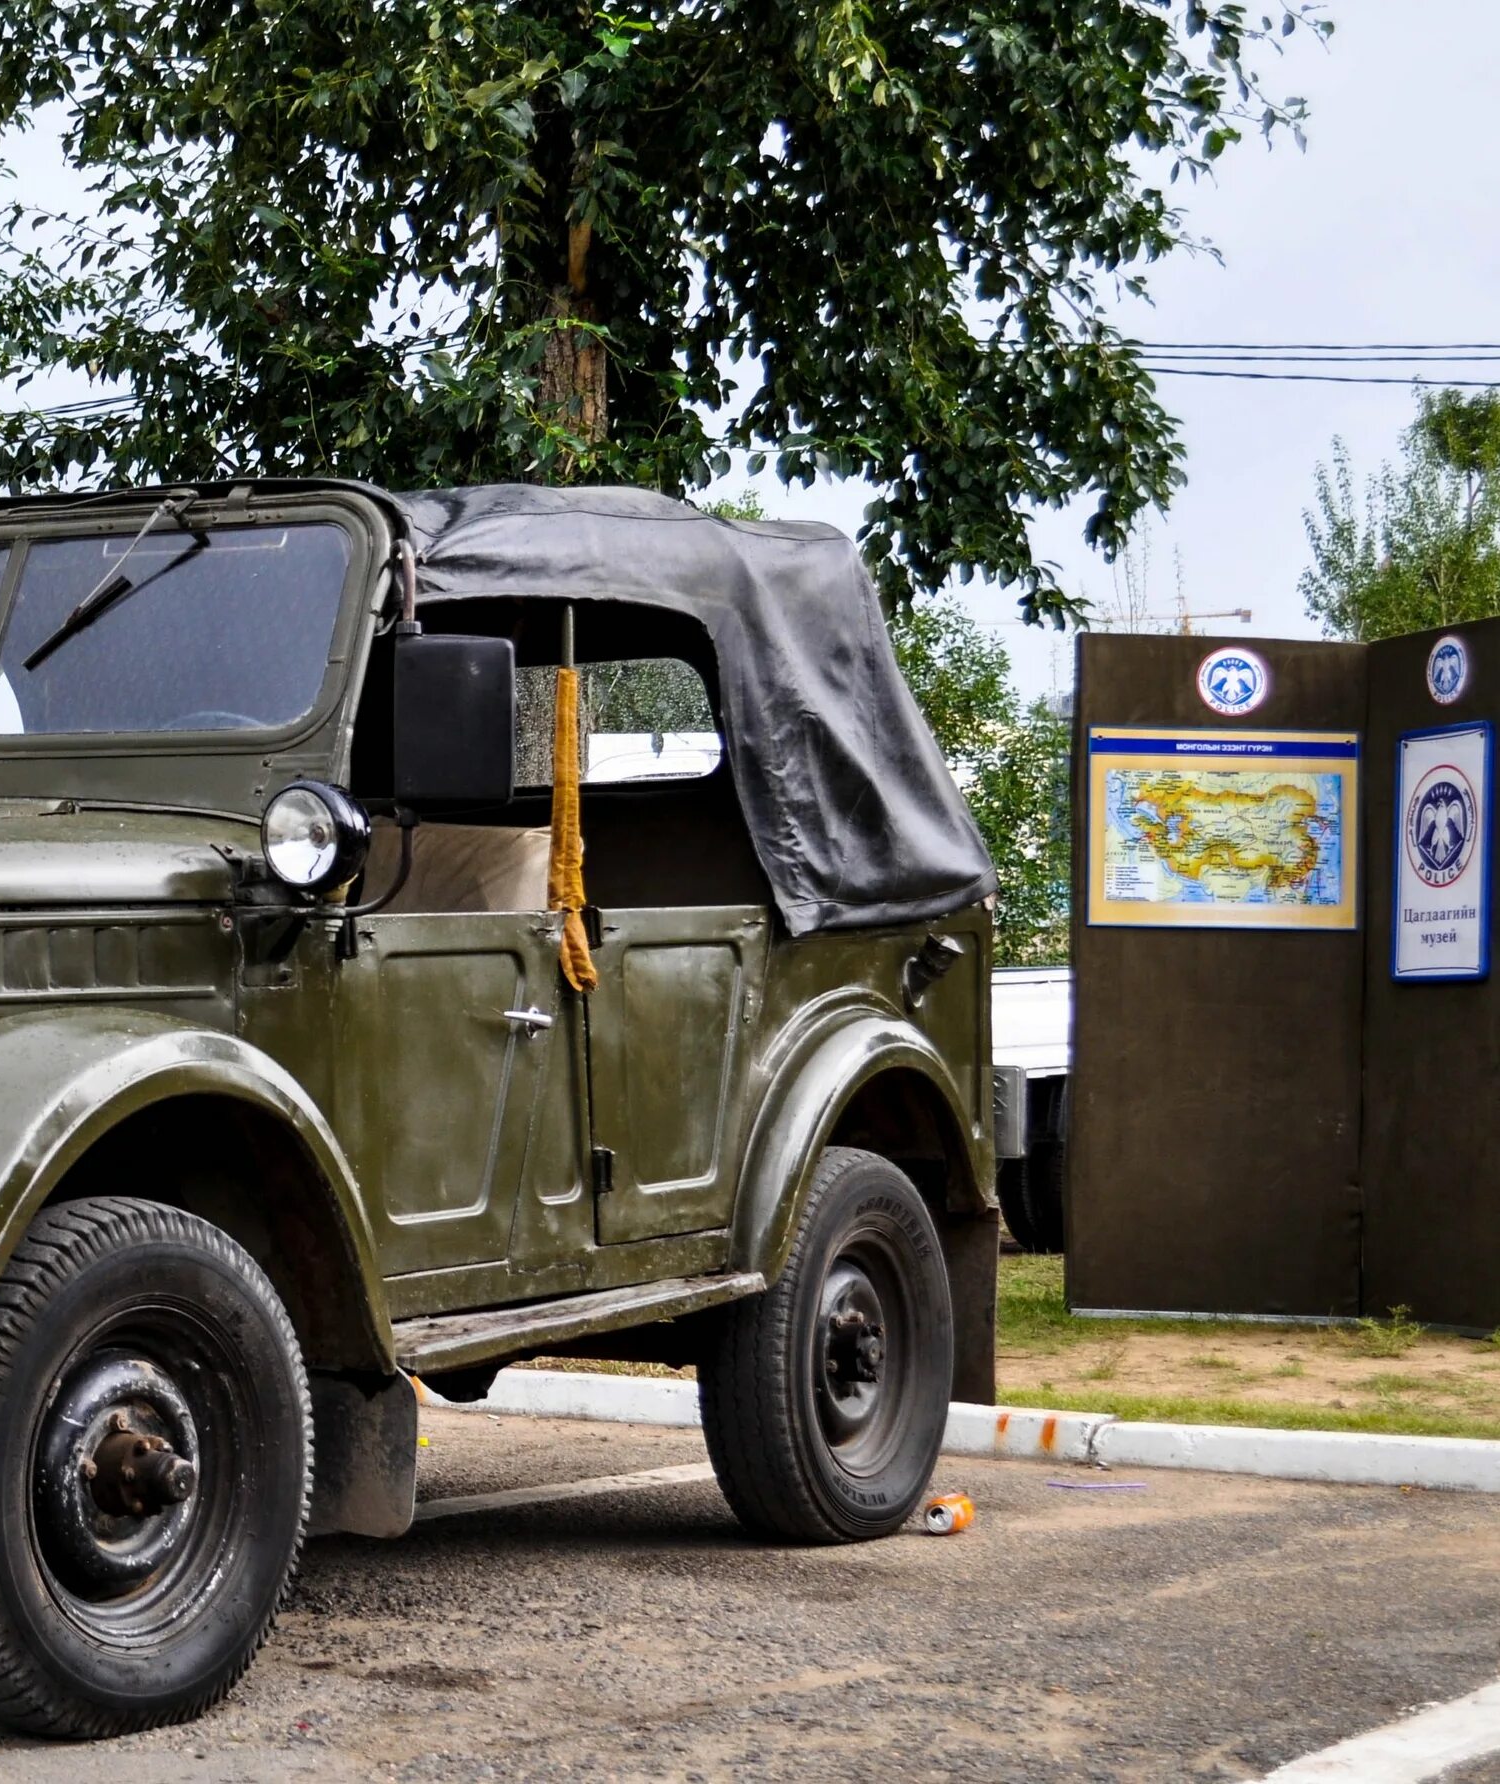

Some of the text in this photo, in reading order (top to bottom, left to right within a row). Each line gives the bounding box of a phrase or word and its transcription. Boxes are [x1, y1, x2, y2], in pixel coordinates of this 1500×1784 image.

[1209, 699, 1252, 713] POLICE
[1175, 743, 1220, 751] МОНГОЛЫН
[1418, 859, 1463, 884] POLICE
[1403, 905, 1476, 923] Цагдаагийн
[1420, 928, 1457, 948] музей
